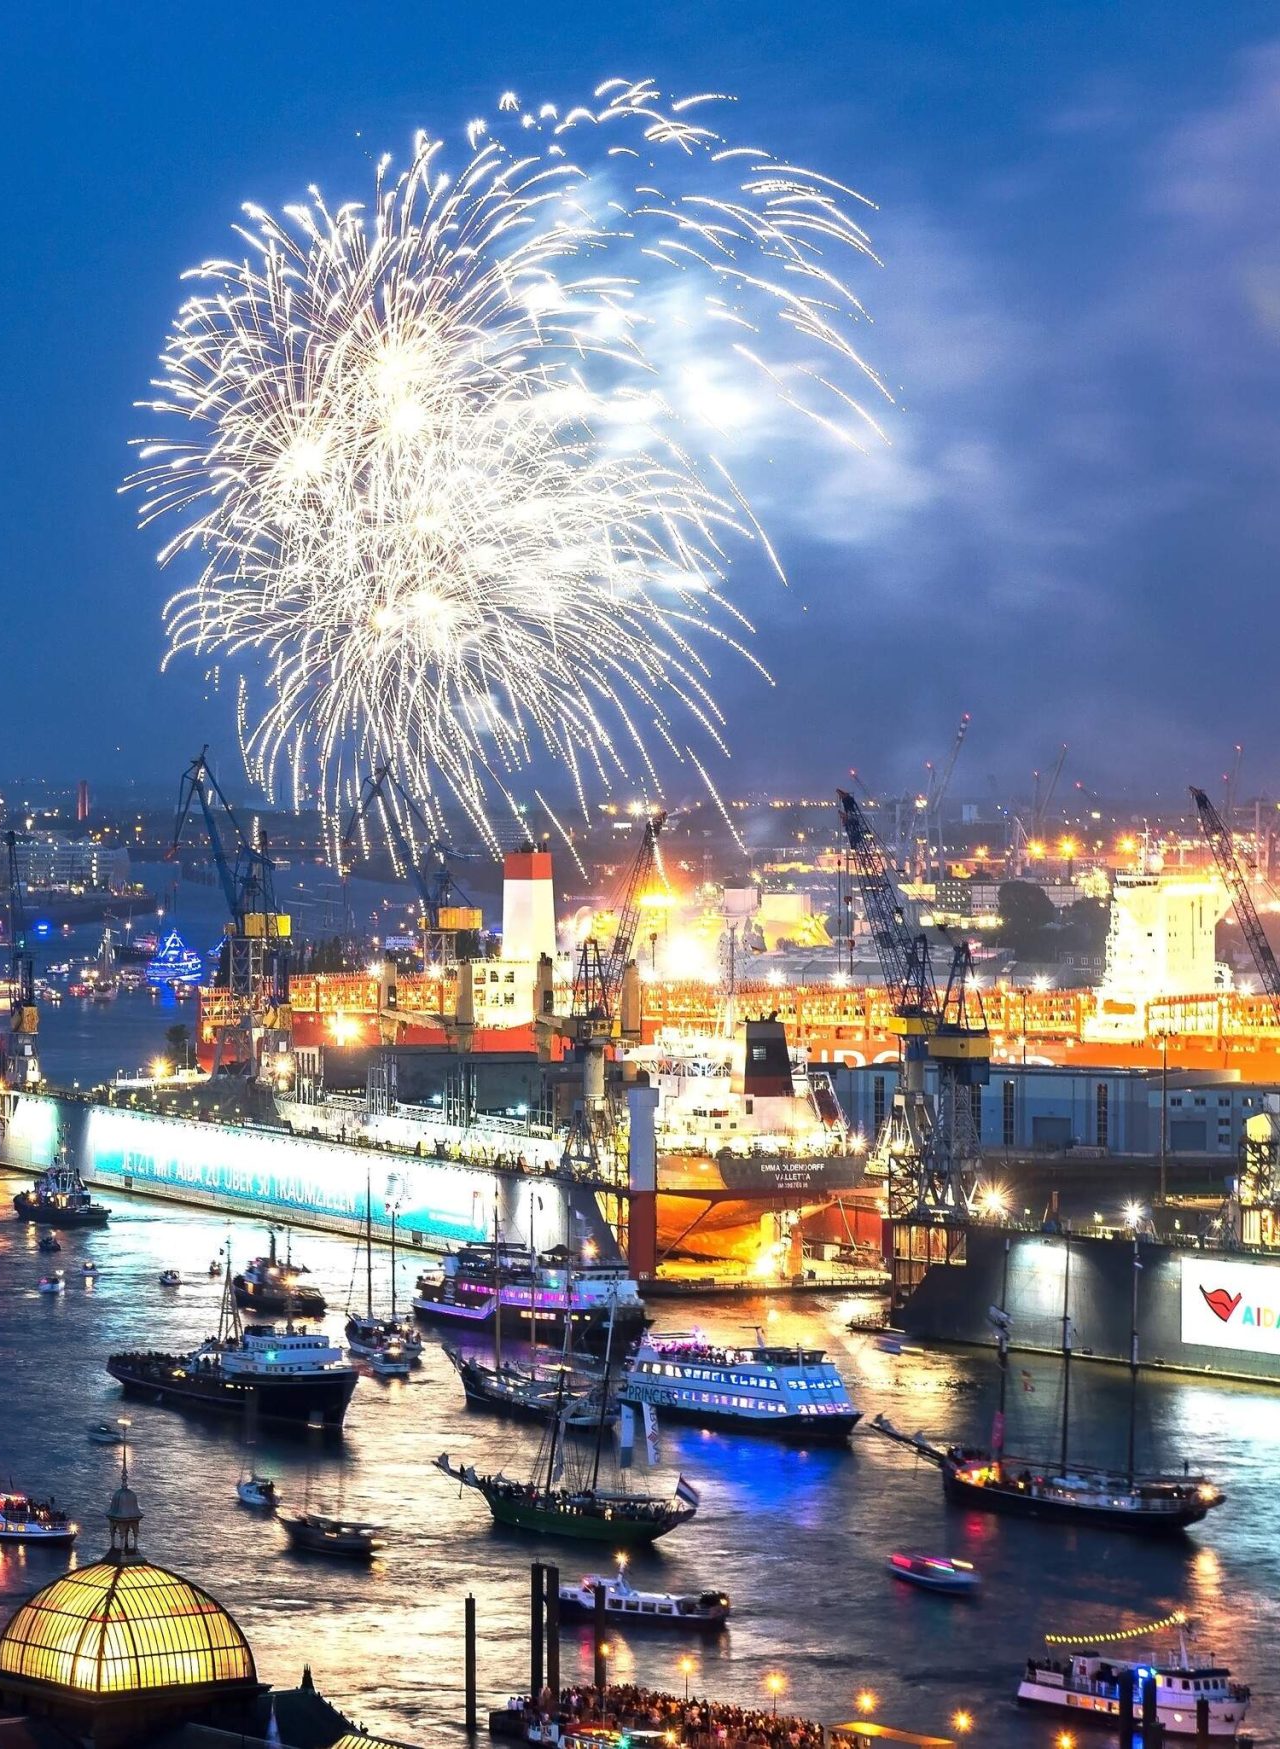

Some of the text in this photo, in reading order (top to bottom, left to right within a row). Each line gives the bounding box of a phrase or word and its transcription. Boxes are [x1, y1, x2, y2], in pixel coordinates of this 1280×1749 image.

[760, 1164, 781, 1172] EMMA
[775, 1173, 811, 1181] VALLETTA
[628, 1385, 678, 1407] PRINCESS
